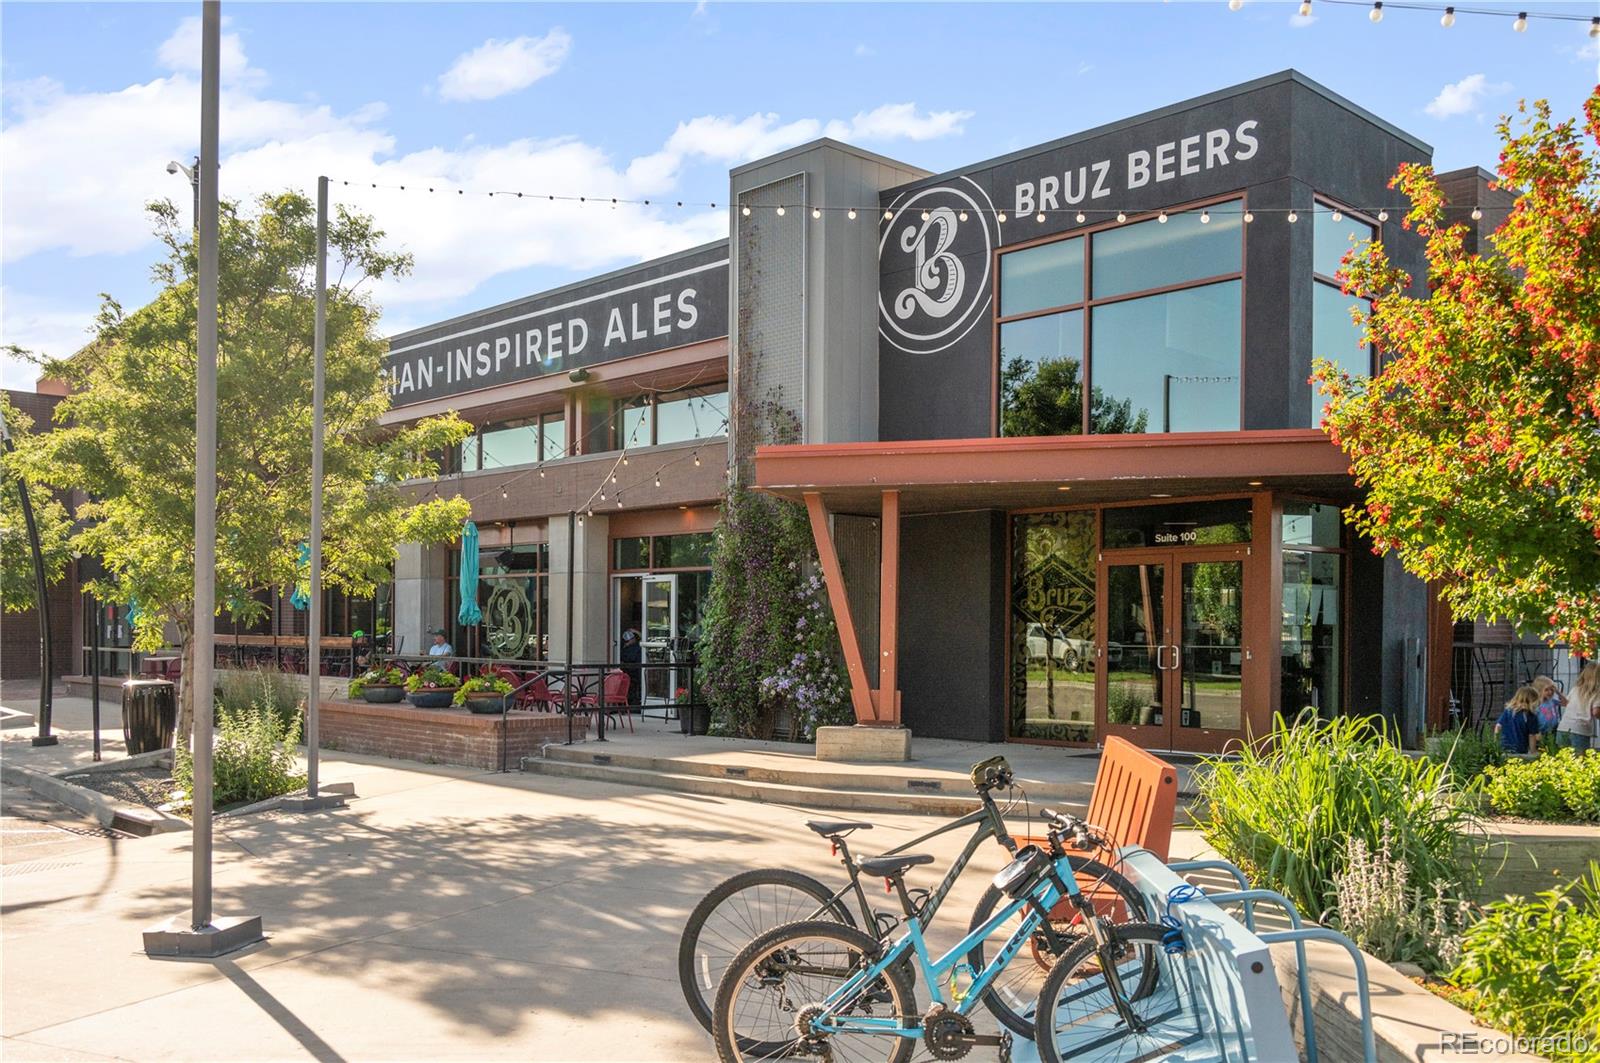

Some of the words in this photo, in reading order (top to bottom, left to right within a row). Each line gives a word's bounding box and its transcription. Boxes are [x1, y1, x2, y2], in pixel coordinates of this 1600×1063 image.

[1015, 160, 1110, 219] BRUZ
[1128, 119, 1259, 189] BEERS
[603, 287, 699, 347] ALES
[1154, 533, 1179, 543] Suite
[1180, 531, 1197, 541] 100
[1021, 572, 1087, 613] Bruz
